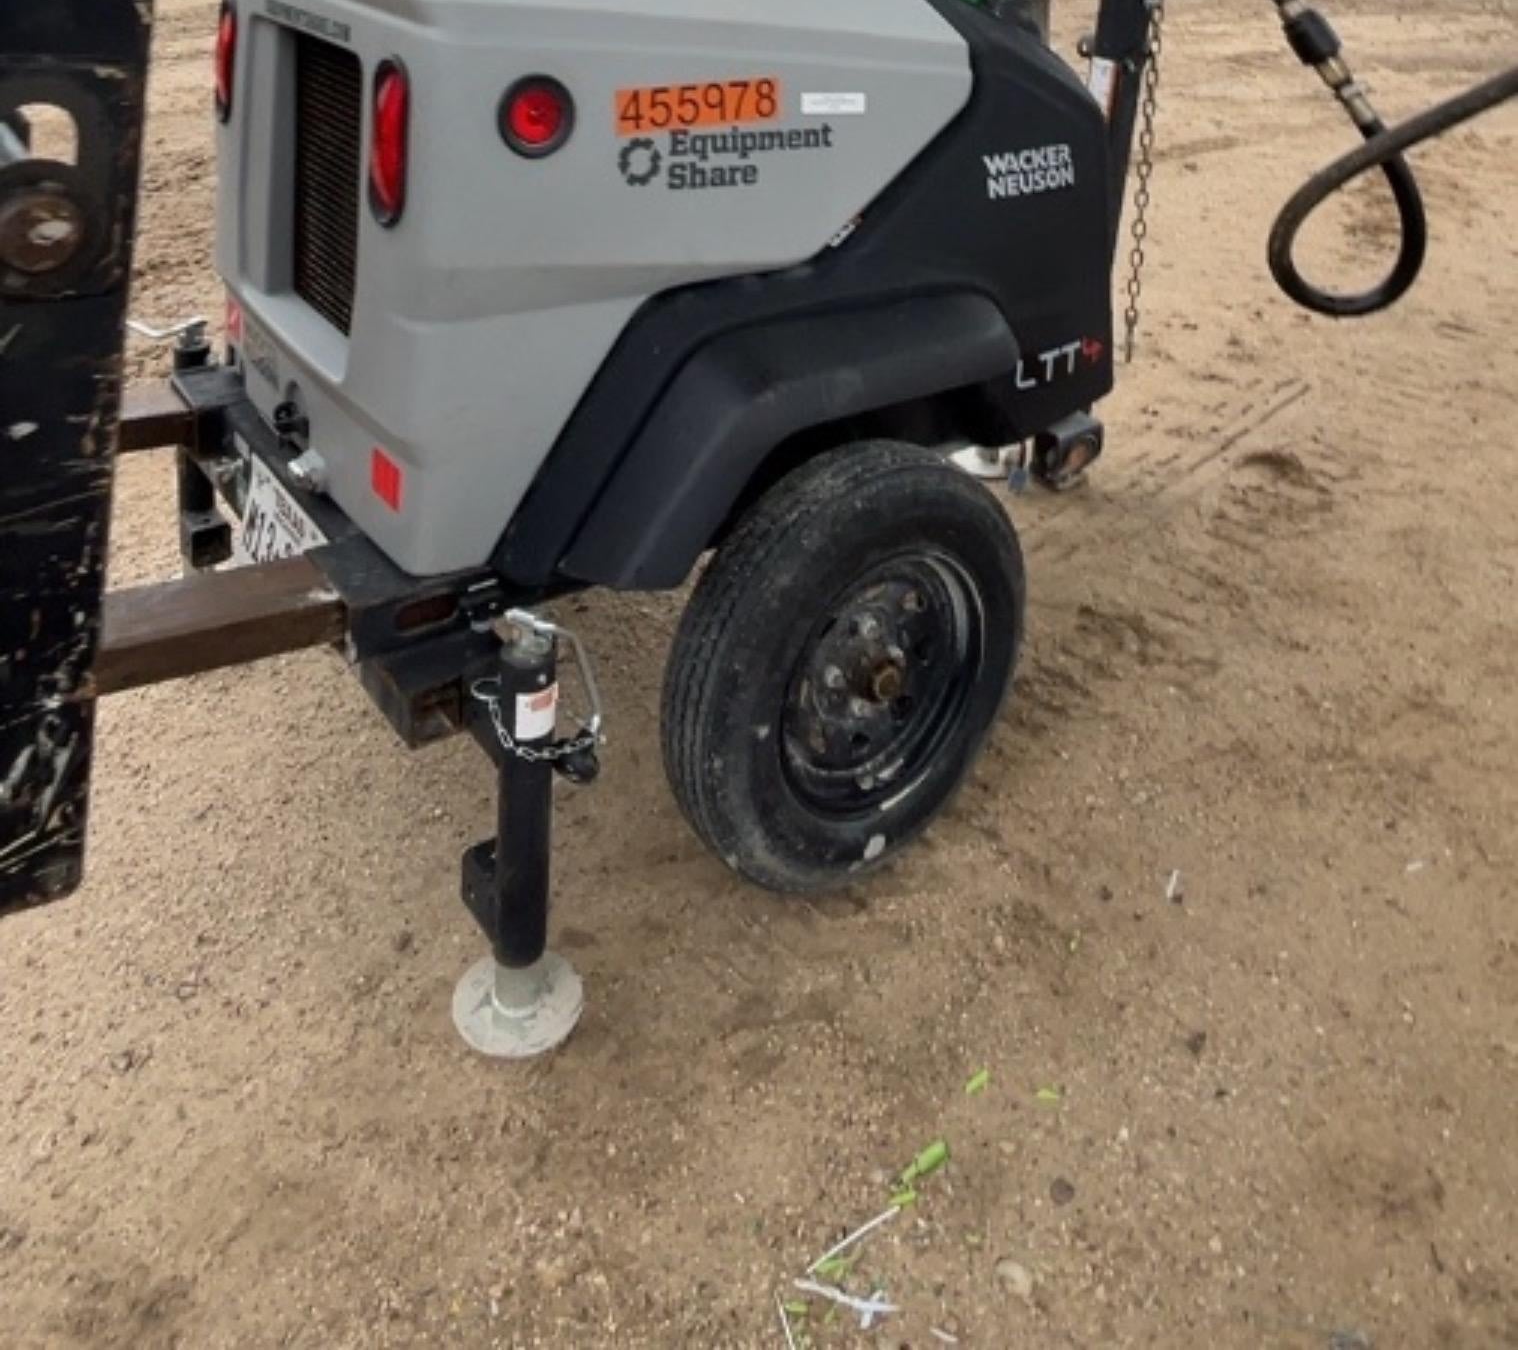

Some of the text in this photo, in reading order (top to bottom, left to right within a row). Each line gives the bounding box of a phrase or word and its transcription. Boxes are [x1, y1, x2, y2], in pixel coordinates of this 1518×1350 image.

[620, 78, 778, 130] 455978
[668, 122, 833, 161] Equipment
[667, 162, 759, 190] Share
[982, 143, 1072, 177] WACKER
[986, 165, 1075, 200] NEUSON
